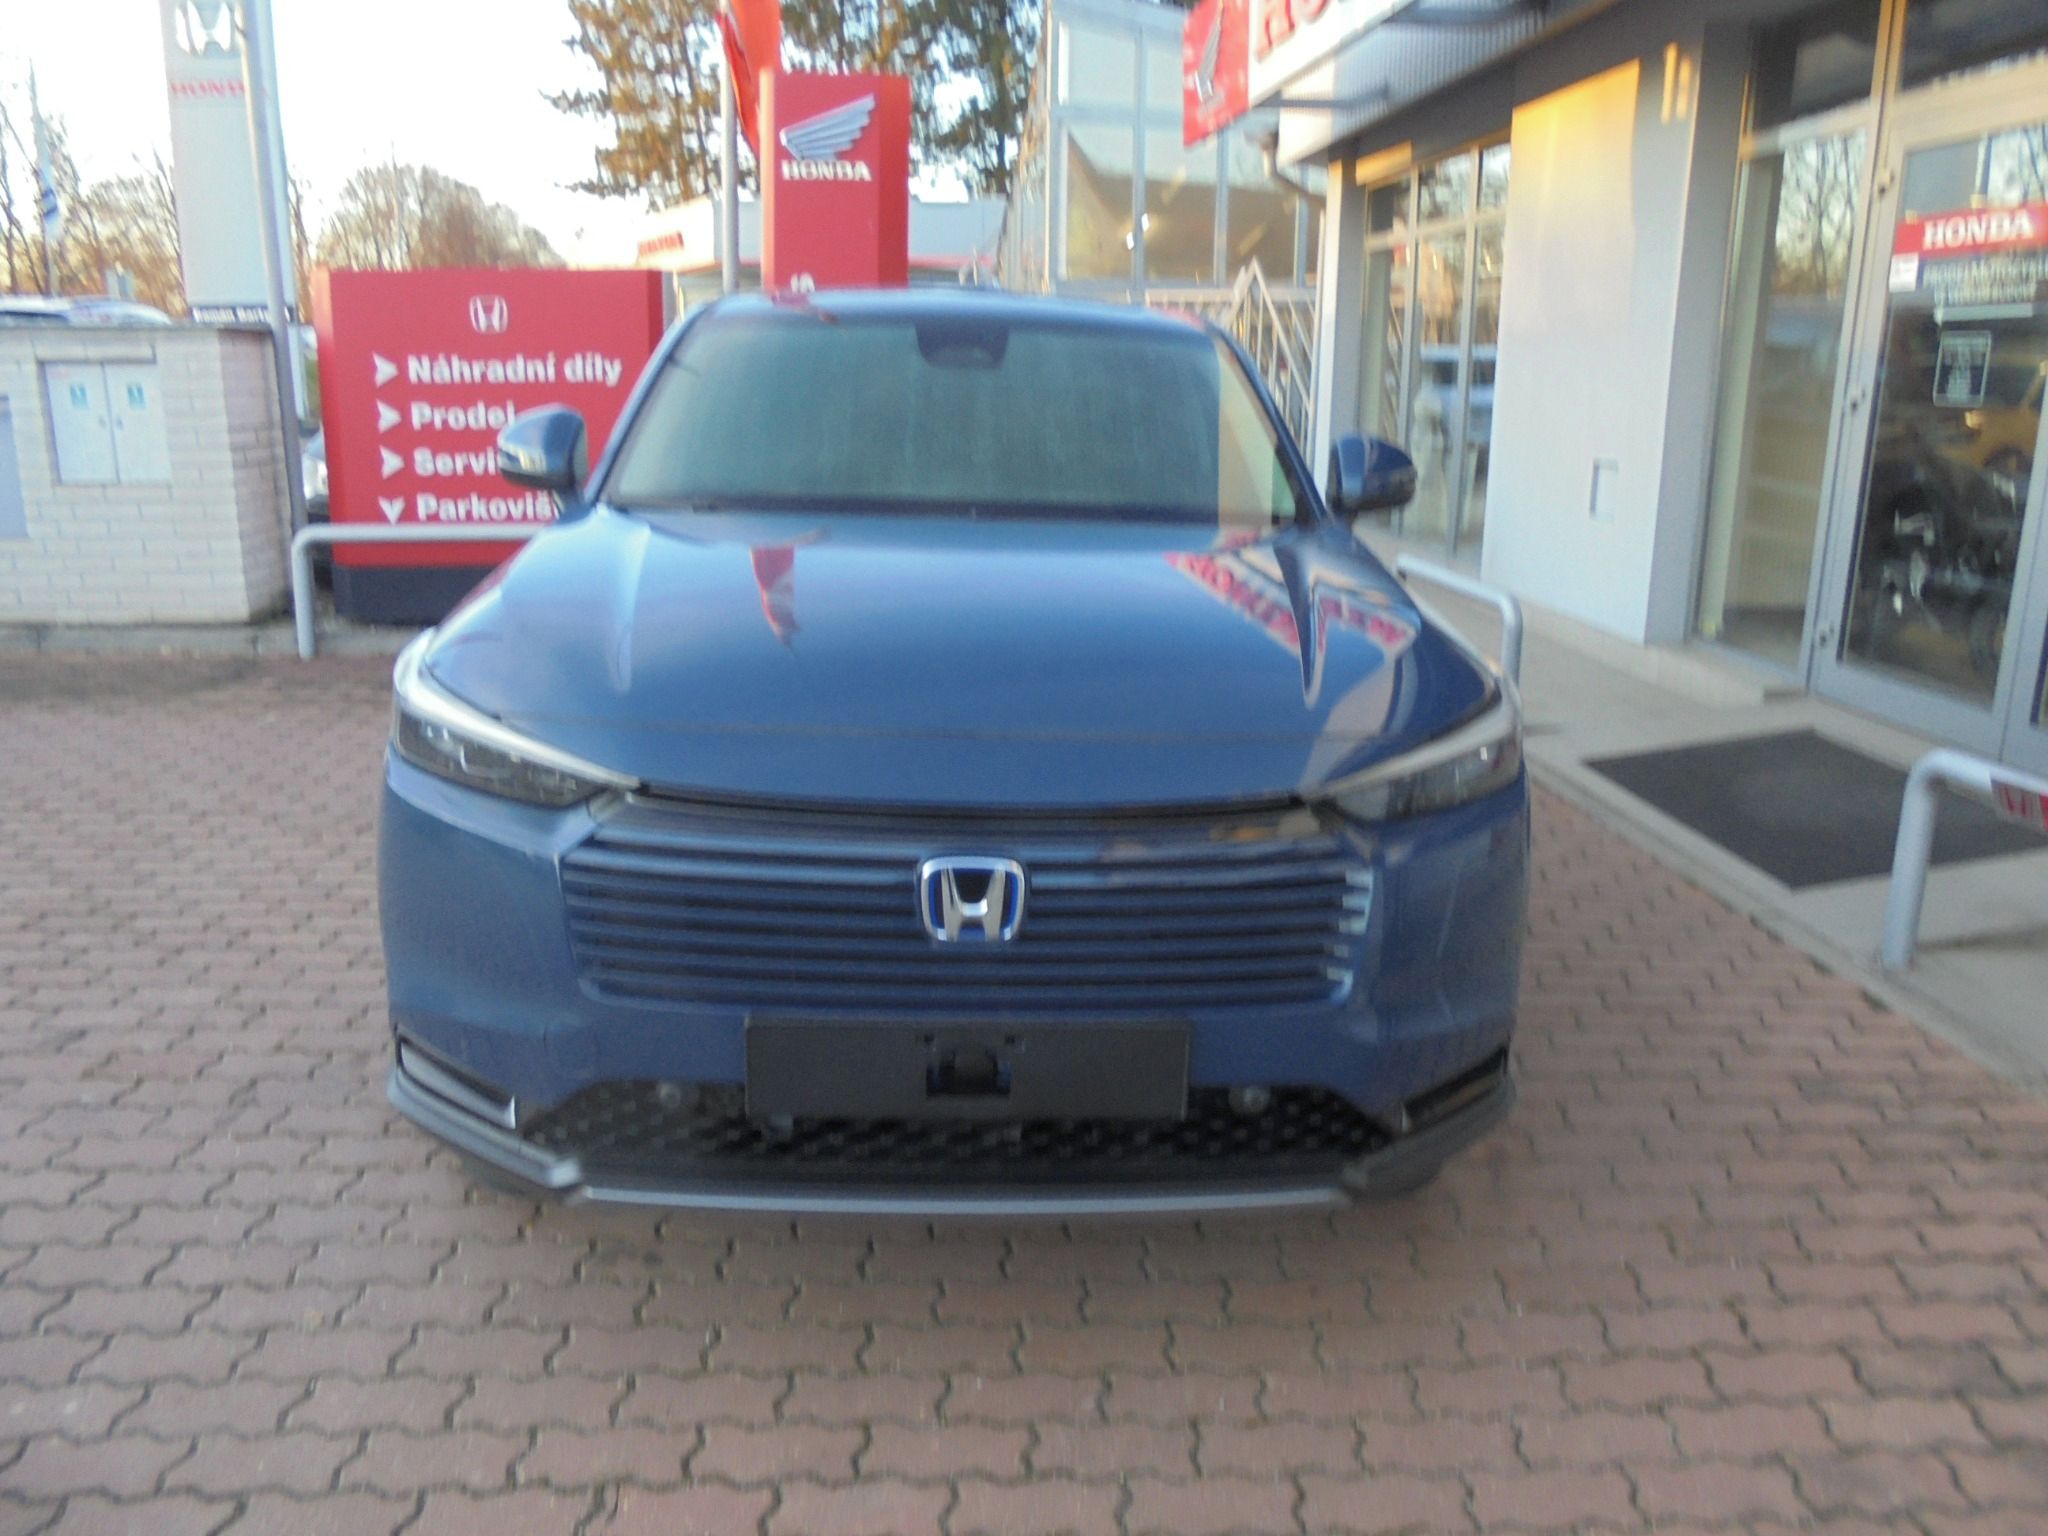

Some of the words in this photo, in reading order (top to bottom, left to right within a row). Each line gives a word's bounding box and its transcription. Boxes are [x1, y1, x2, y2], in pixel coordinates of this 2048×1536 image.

[170, 79, 268, 97] HOND
[780, 159, 873, 182] HONDA
[1923, 207, 2036, 251] HONDA
[407, 352, 556, 385] Náhradní
[563, 352, 623, 388] díly
[413, 446, 504, 477] Servi
[416, 490, 562, 522] Parkoviš
